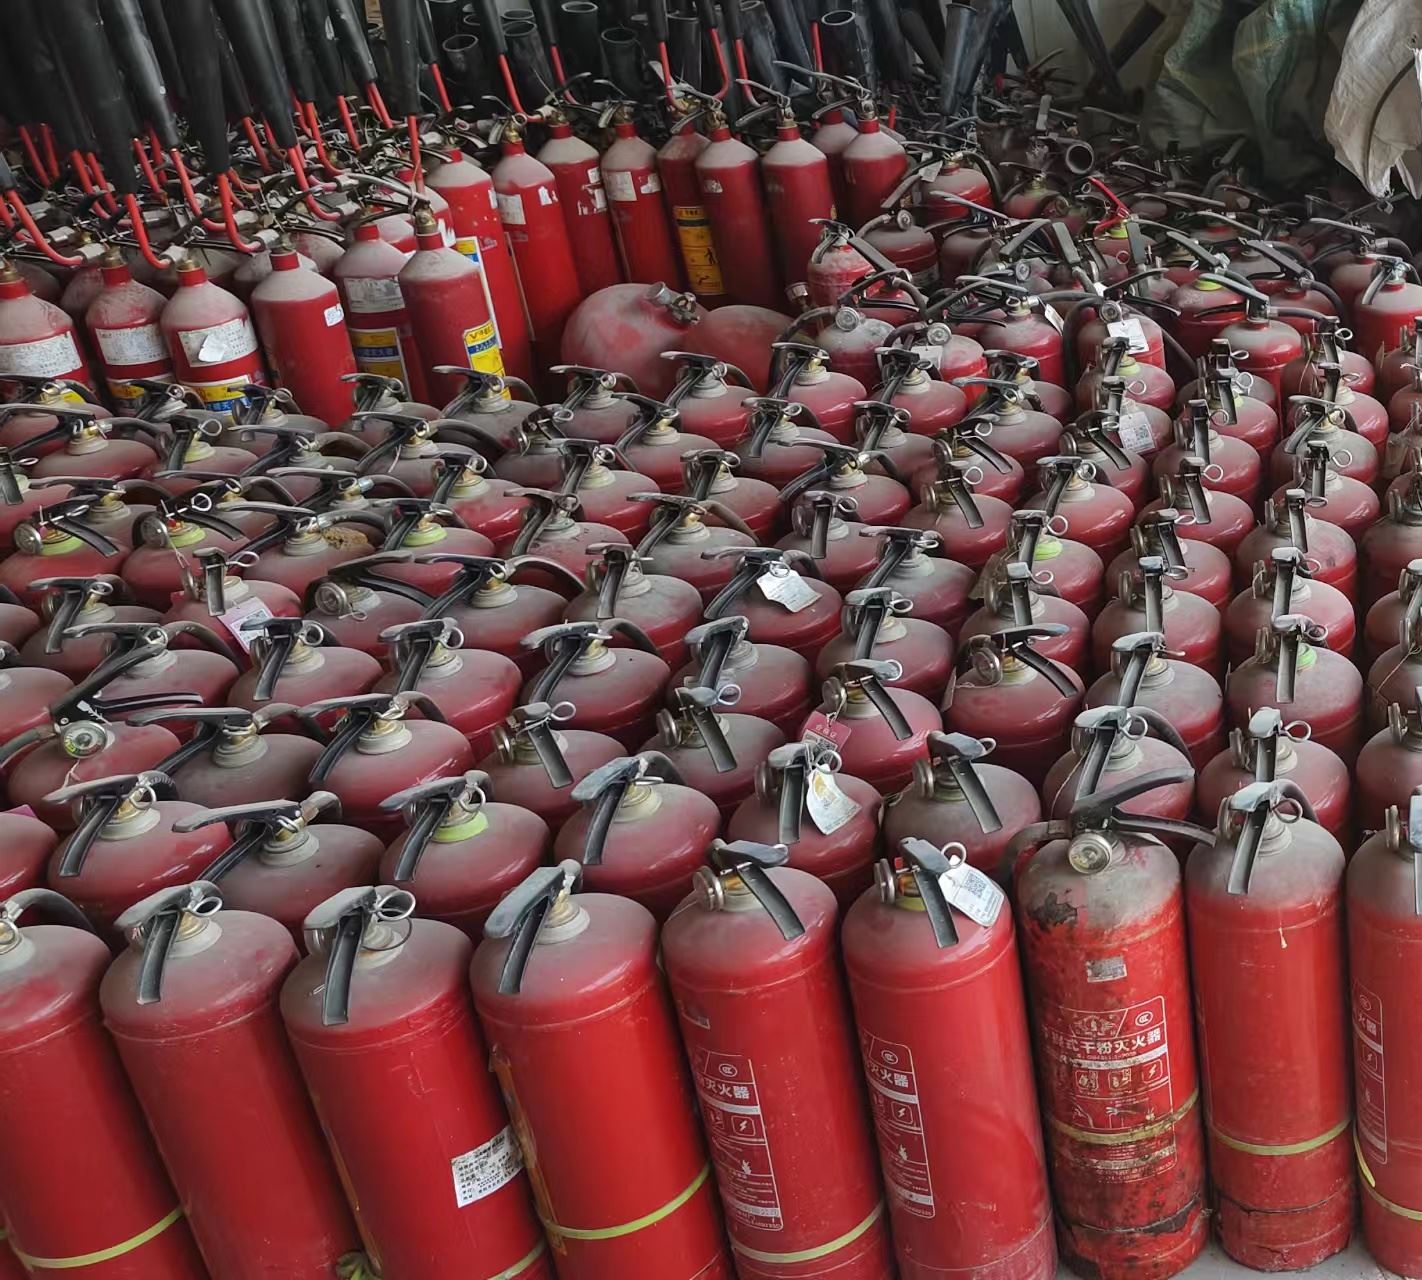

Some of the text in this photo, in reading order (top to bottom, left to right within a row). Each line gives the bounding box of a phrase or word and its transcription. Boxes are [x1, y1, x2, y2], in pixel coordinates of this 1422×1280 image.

[698, 1074, 750, 1100] 灭火器
[866, 1060, 909, 1088] 灭火器
